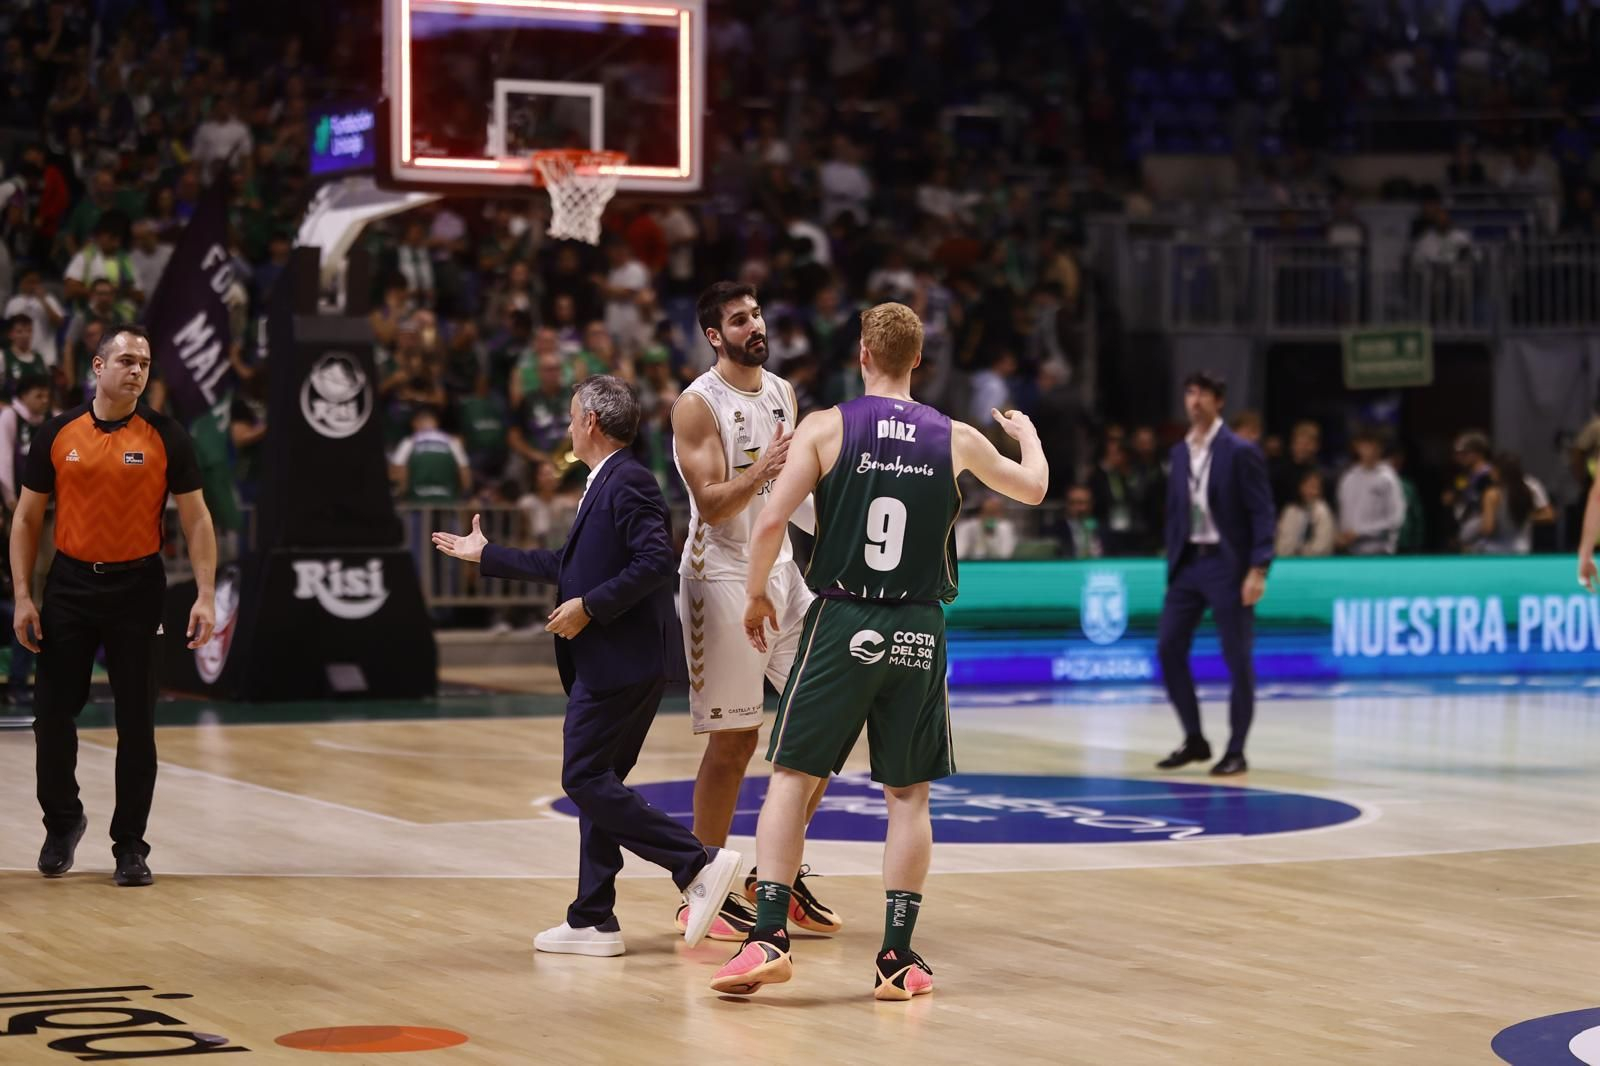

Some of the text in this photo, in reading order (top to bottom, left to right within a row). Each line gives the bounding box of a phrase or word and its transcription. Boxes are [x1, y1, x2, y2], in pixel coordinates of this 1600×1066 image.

[877, 416, 916, 443] DÍAZ
[864, 496, 907, 572] 9
[292, 559, 389, 619] Risi
[893, 631, 935, 648] COSTA
[1333, 598, 1508, 658] NUESTRA
[891, 645, 915, 657] DEL
[1051, 658, 1151, 681] PIZARRA
